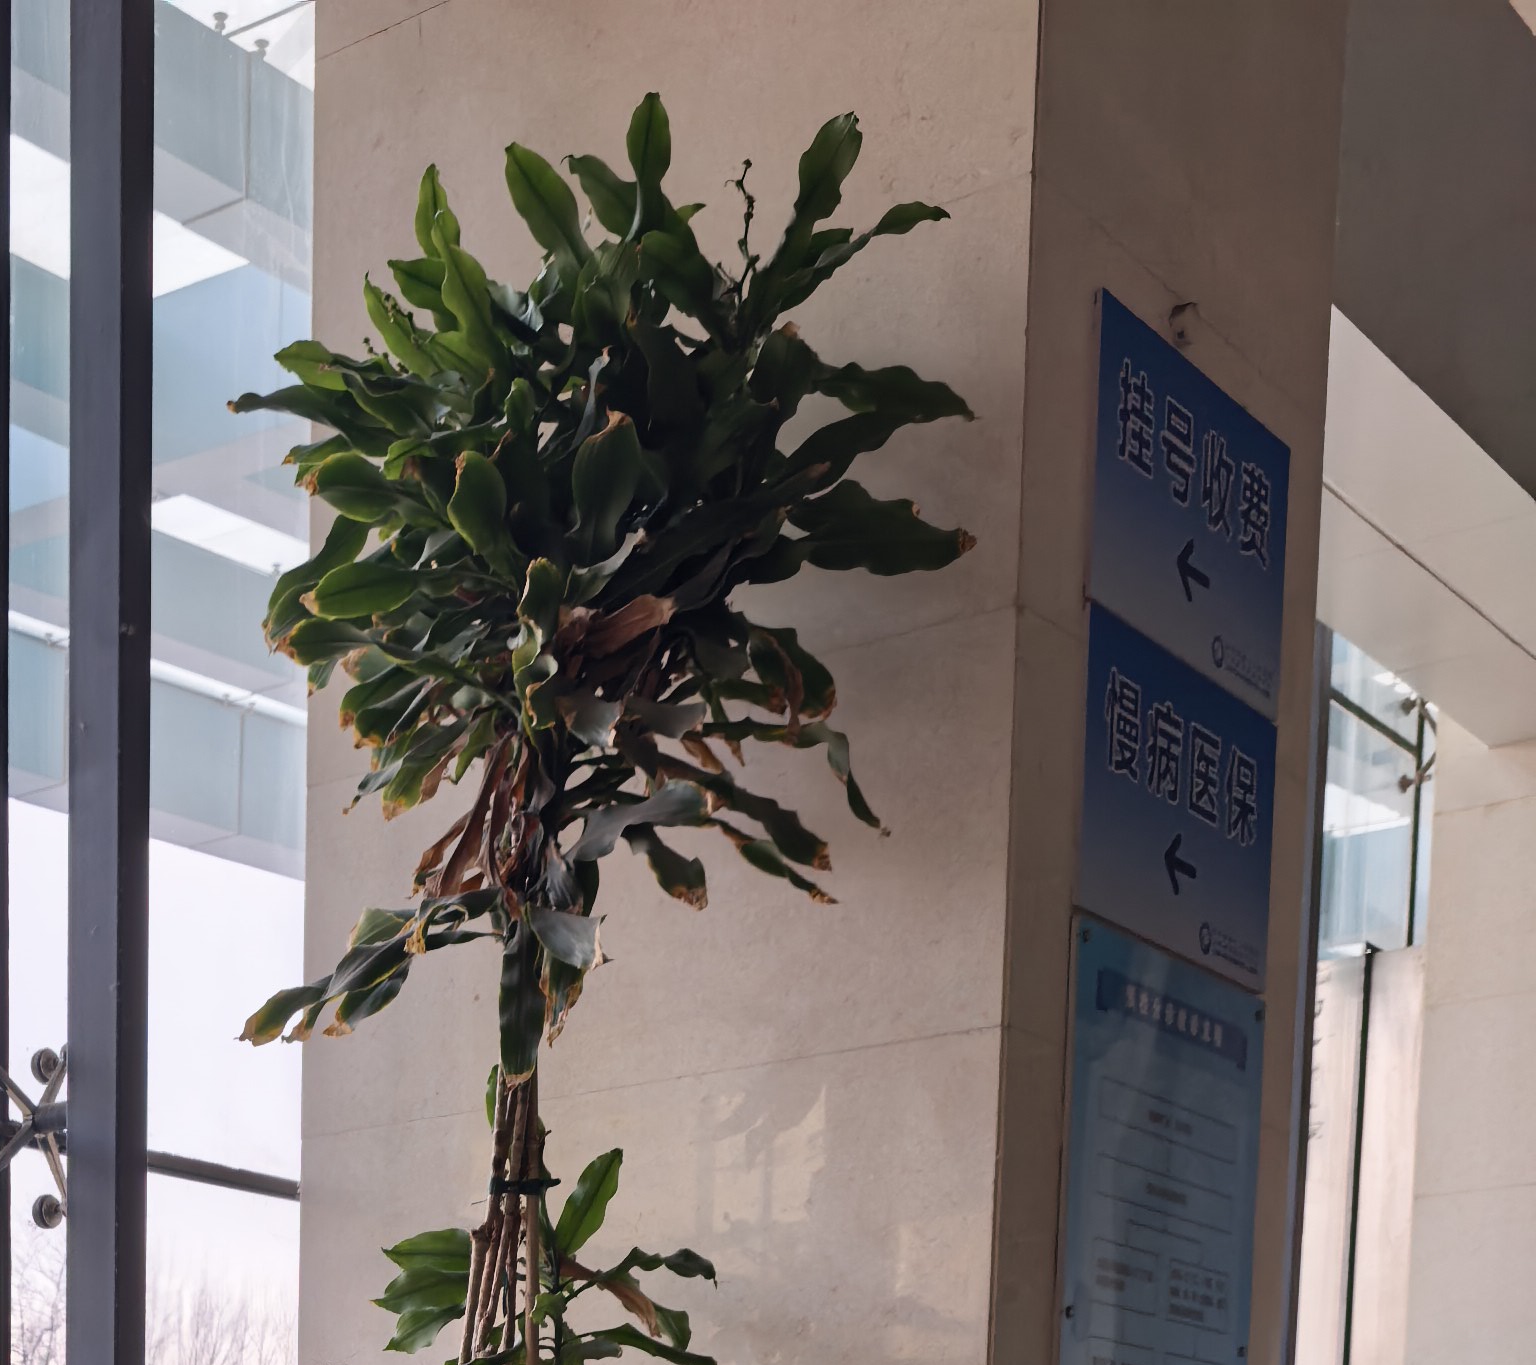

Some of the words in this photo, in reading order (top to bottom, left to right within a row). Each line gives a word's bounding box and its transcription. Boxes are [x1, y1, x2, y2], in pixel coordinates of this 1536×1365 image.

[1118, 357, 1271, 569] 挂号收费
[1104, 666, 1257, 848] 慢病医保
